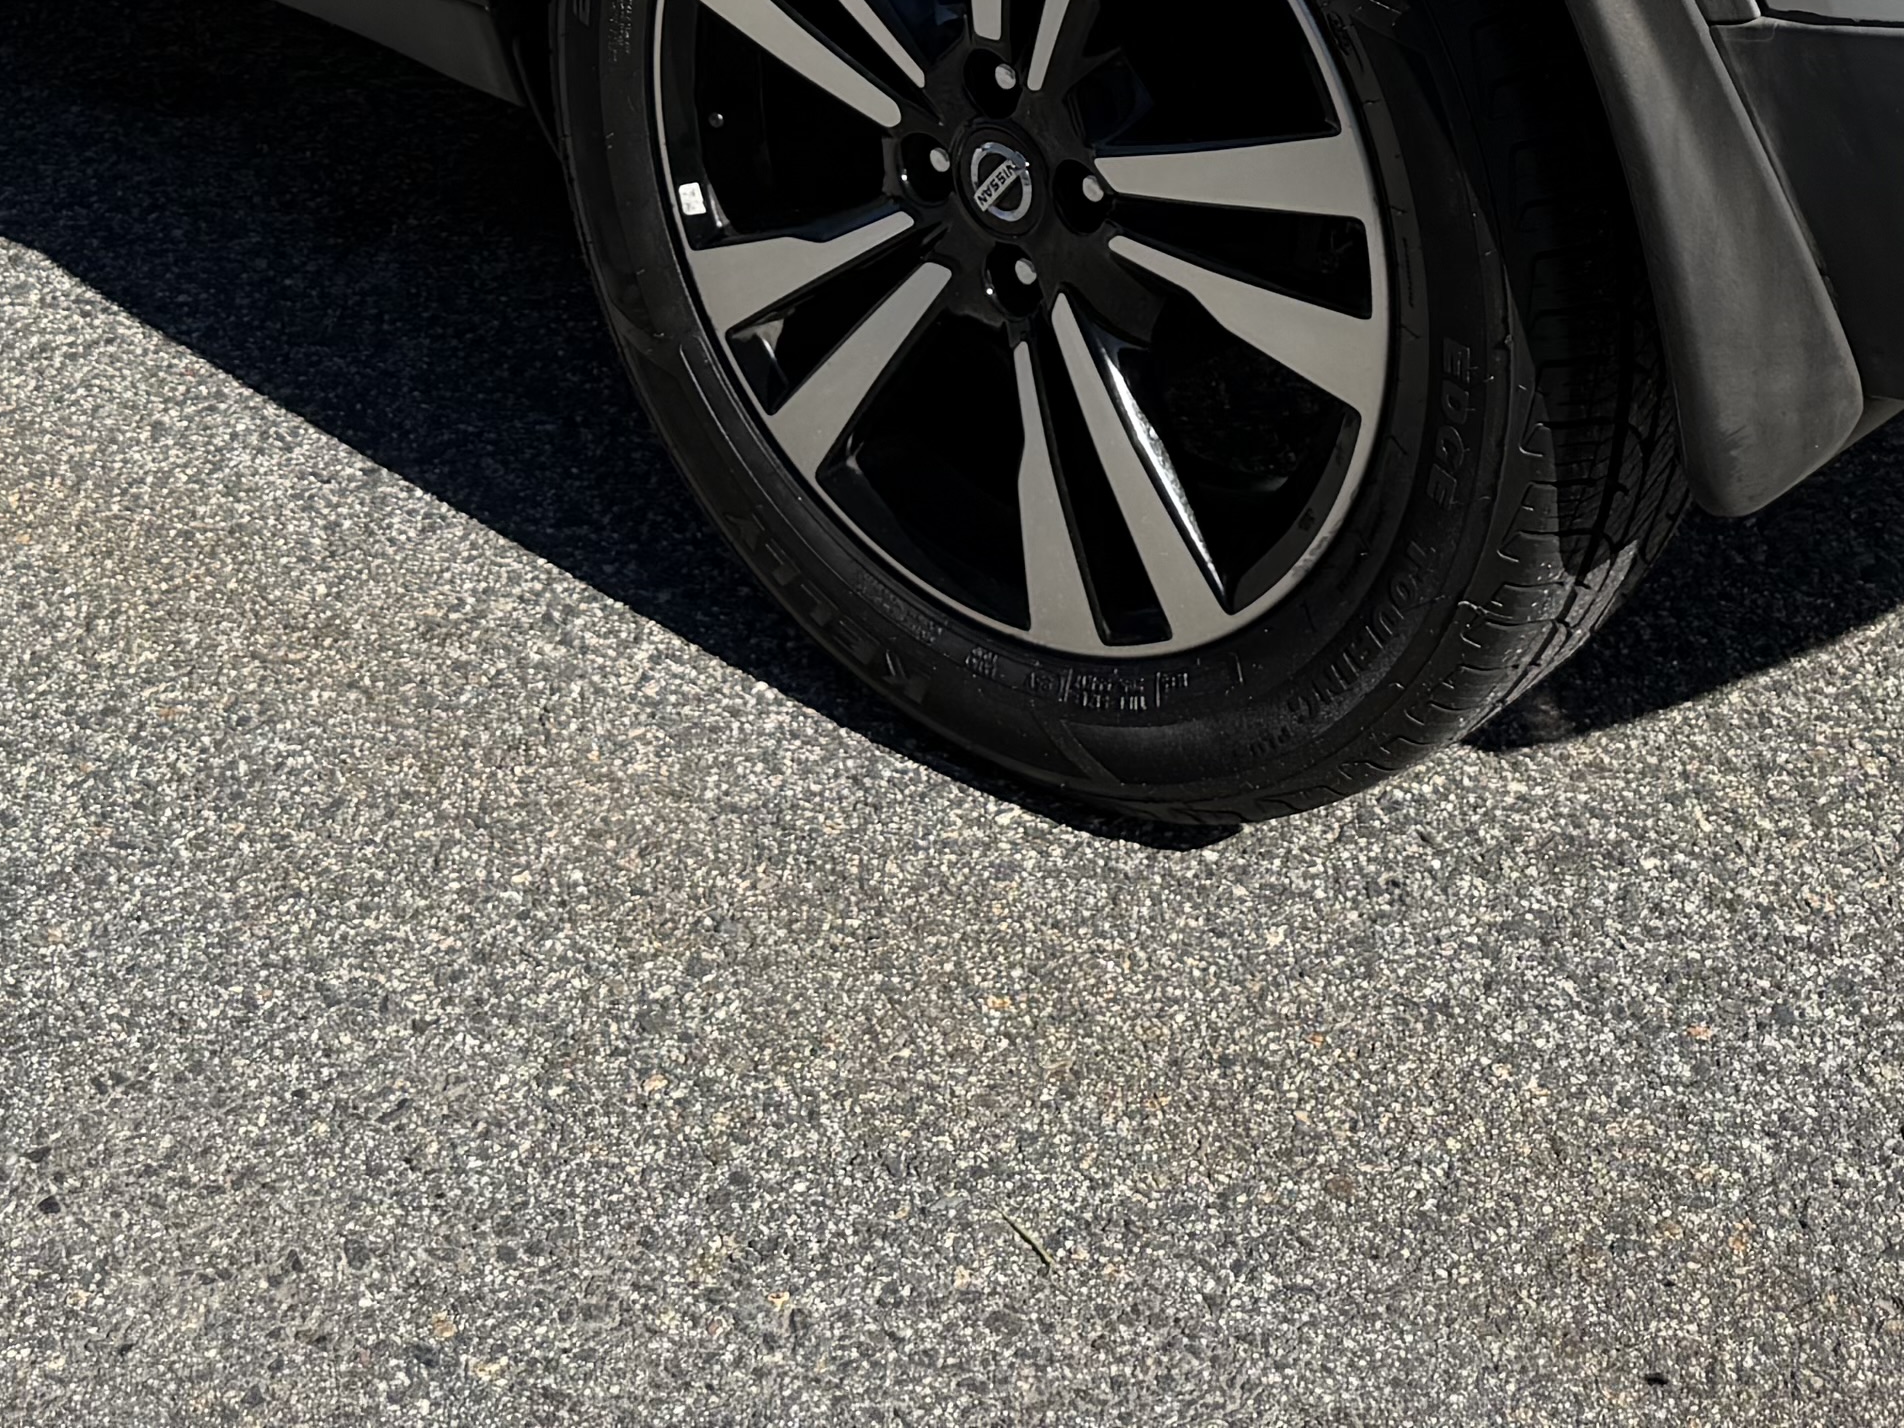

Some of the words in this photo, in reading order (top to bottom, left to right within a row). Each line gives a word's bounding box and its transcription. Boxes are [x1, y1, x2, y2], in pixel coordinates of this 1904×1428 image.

[977, 162, 1016, 207] NISSAN
[1426, 336, 1473, 511] EDGE
[726, 511, 932, 705] KELLY
